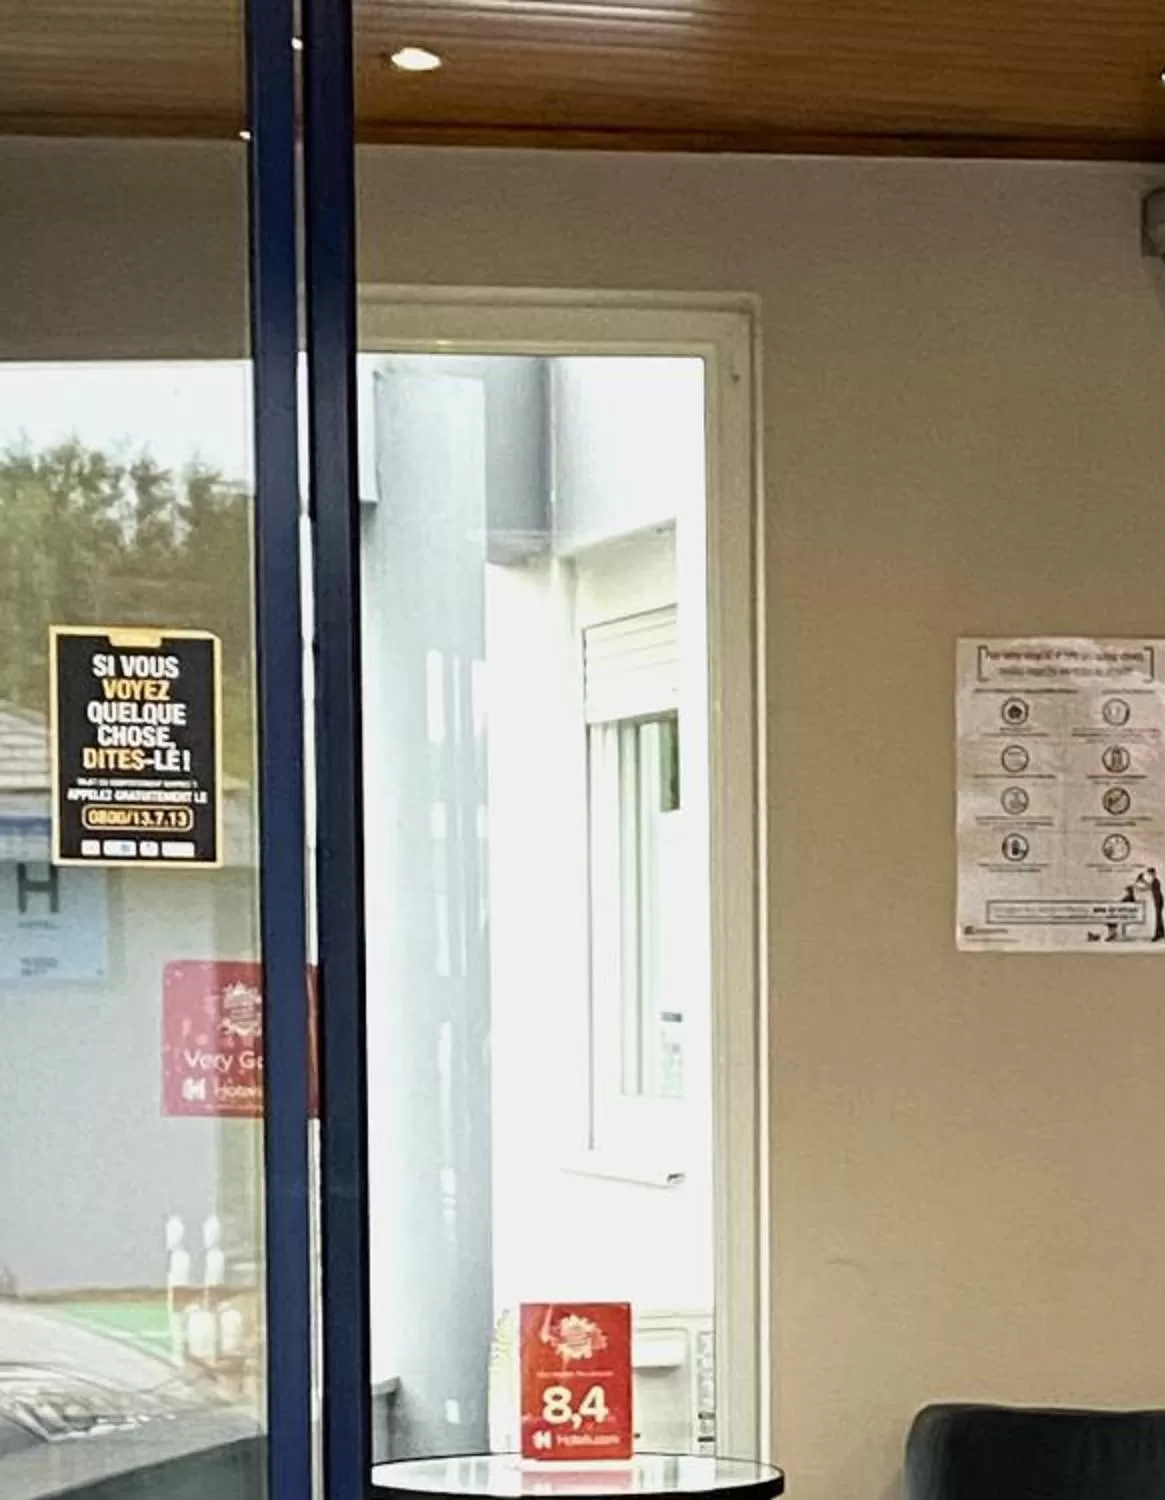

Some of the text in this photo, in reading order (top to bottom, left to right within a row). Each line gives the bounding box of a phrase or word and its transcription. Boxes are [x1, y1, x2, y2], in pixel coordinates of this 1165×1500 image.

[92, 654, 180, 679] SI VOUS
[102, 678, 171, 701] VOYEZ
[87, 701, 188, 726] QUELQUE
[97, 724, 177, 750] CHOSE,
[183, 1048, 234, 1074] Very
[542, 1385, 609, 1430] 8,4
